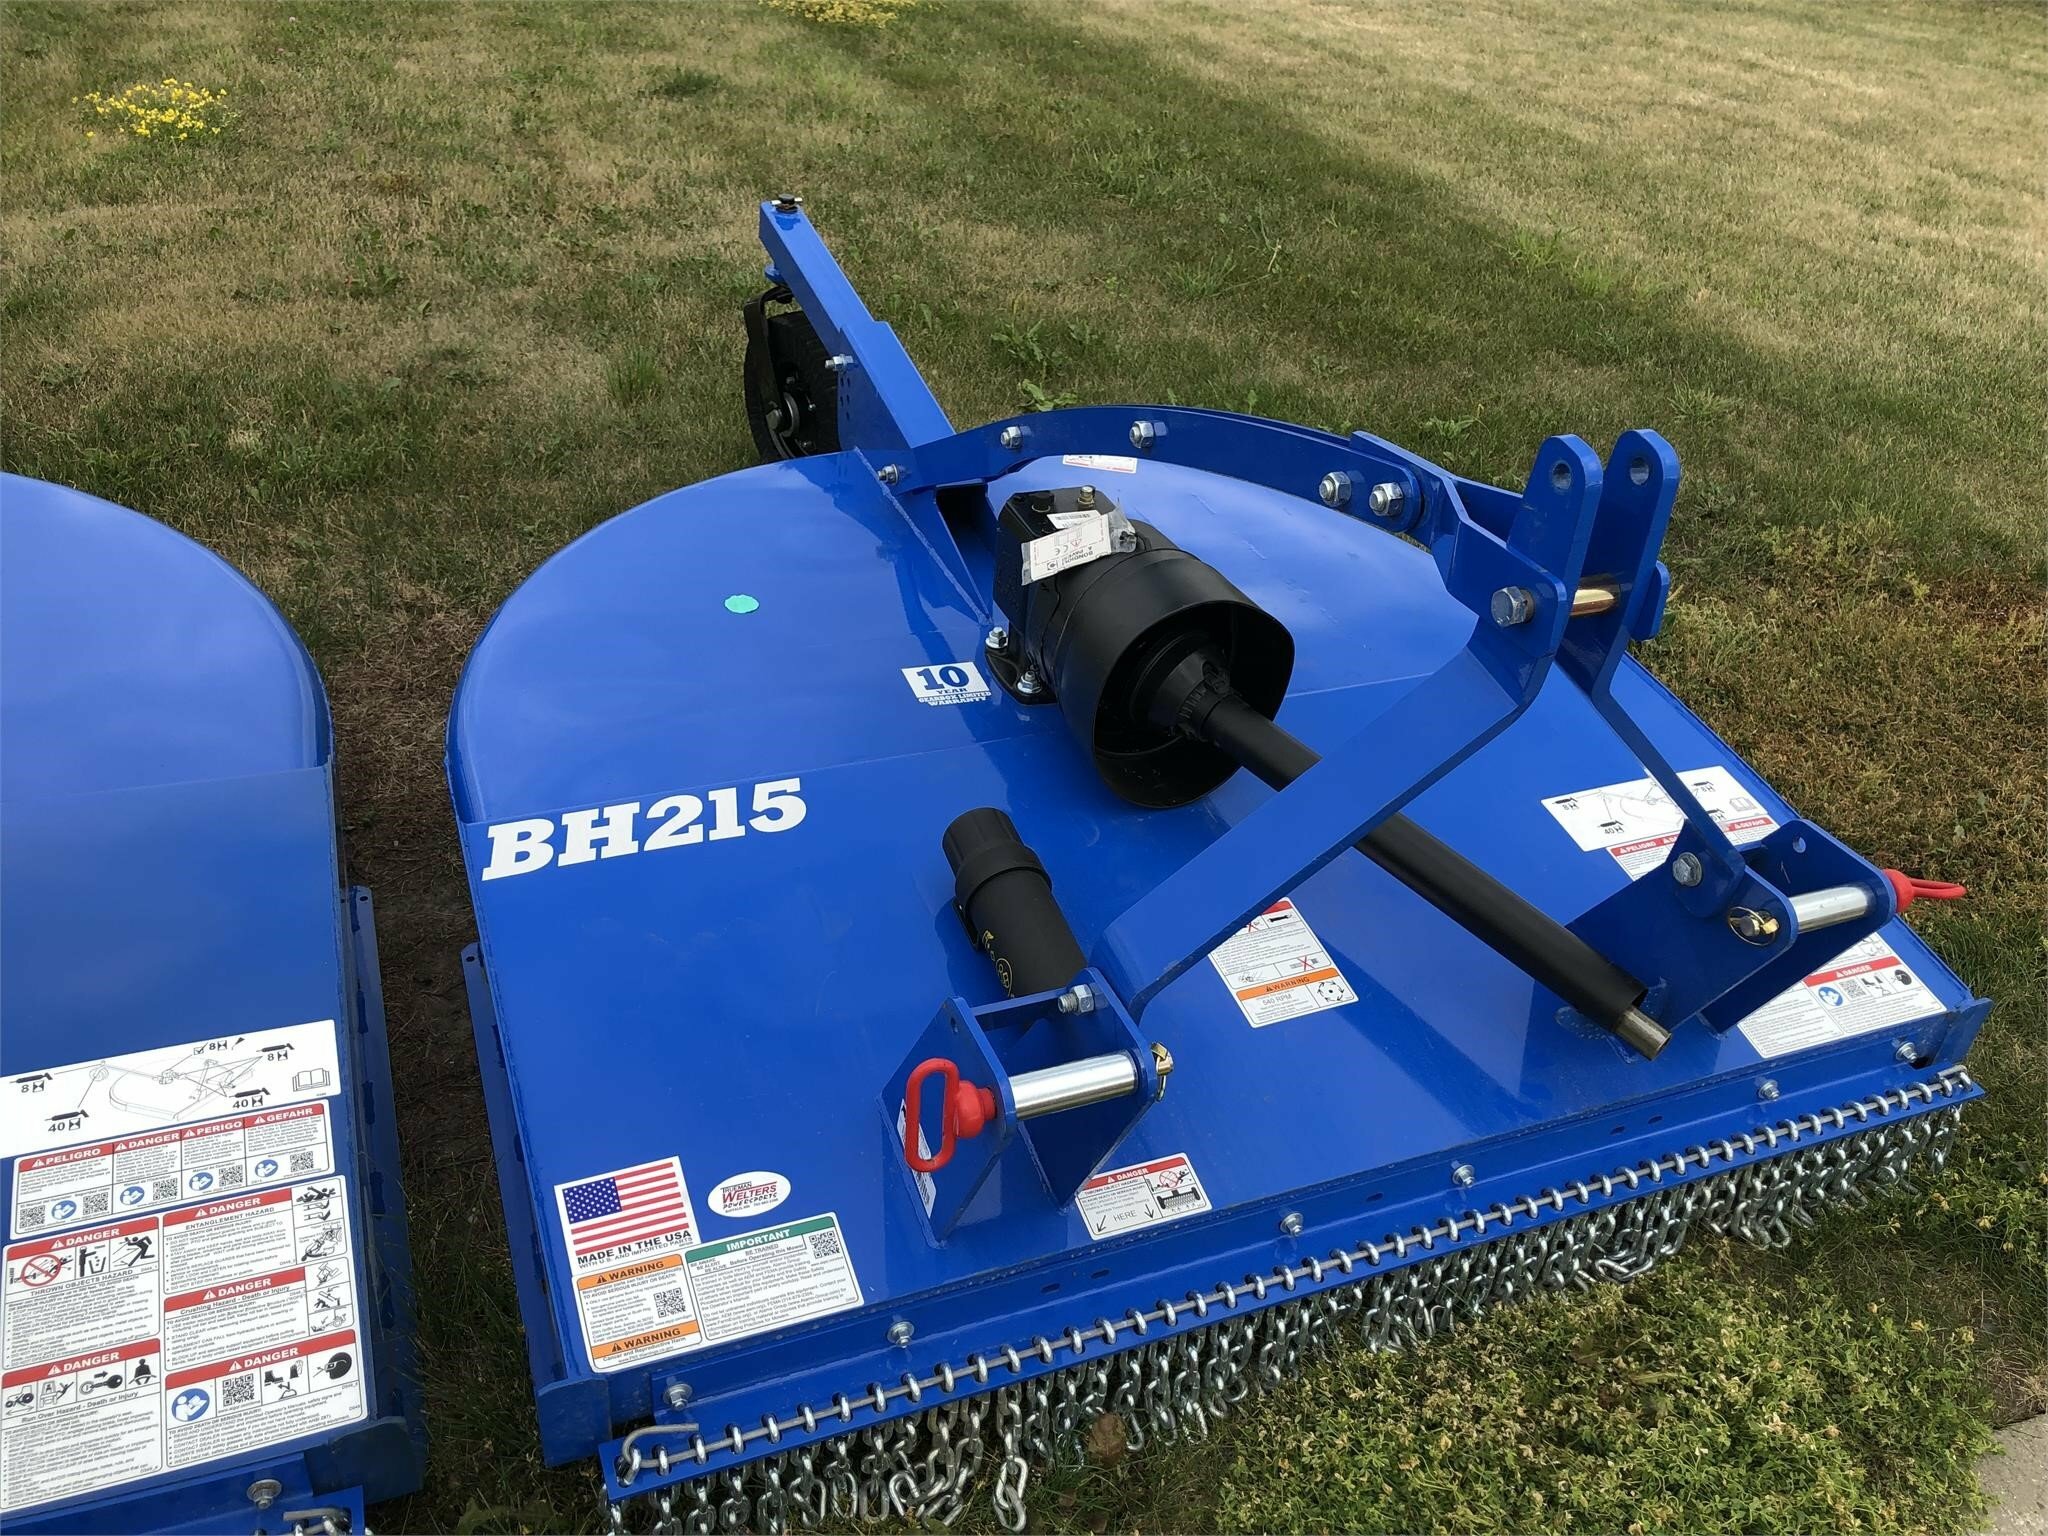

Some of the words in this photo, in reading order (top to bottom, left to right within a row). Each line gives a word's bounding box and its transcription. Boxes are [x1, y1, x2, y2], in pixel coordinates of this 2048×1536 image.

[916, 666, 969, 690] 10
[928, 697, 986, 706] WARRANTY
[482, 778, 807, 881] BH215
[1627, 841, 1656, 852] PELIGRO
[1843, 965, 1872, 976] DANGER
[1274, 977, 1310, 990] WARNING
[1276, 994, 1293, 1002] RPM
[209, 1042, 216, 1050] 8
[267, 1053, 274, 1061] 8
[21, 1082, 29, 1093] 8
[233, 1099, 249, 1109] 40
[267, 1107, 313, 1122] GEFAHR
[48, 1121, 65, 1132] 40
[196, 1120, 242, 1135] PERIGO
[128, 1132, 179, 1148] DANGER
[46, 1147, 100, 1164] PELIGRO
[1117, 1168, 1149, 1180] DANGER
[720, 1181, 752, 1193] TRUEMAN
[723, 1183, 777, 1203] WELTERS
[209, 1197, 260, 1214] DANGER
[723, 1193, 777, 1209] POWERSPORTS
[185, 1213, 243, 1230] ENTANGLEMENT
[245, 1206, 274, 1217] HAZARD
[1113, 1210, 1137, 1222] HERE
[66, 1228, 119, 1246] DANGER
[725, 1227, 791, 1252] IMPORTANT
[576, 1248, 614, 1265] MADE
[617, 1244, 631, 1254] IN
[635, 1236, 663, 1250] THE
[664, 1228, 691, 1242] USA
[578, 1260, 597, 1269] WITH
[614, 1252, 629, 1260] AND
[631, 1242, 668, 1256] IMPORTED
[669, 1235, 692, 1246] PARTS
[729, 1257, 747, 1265] Before
[748, 1250, 774, 1261] Operating
[786, 1243, 803, 1251] Mower
[754, 1243, 779, 1253] TRAINED
[608, 1261, 664, 1280] WARNING
[704, 1260, 720, 1268] ALERT
[30, 1284, 63, 1296] THROWN
[65, 1276, 99, 1288] OBJECTS
[102, 1269, 132, 1280] HAZARD
[218, 1278, 271, 1296] DANGER
[180, 1303, 210, 1315] Crushing
[213, 1298, 236, 1307] Hazard
[241, 1292, 261, 1300] Death
[271, 1285, 289, 1294] Injury
[623, 1327, 680, 1349] WARNING
[634, 1340, 670, 1354] Reproductive
[63, 1350, 119, 1372] DANGER
[243, 1346, 298, 1368] DANGER
[37, 1410, 54, 1419] Over
[56, 1404, 80, 1414] Hazard
[87, 1398, 107, 1407] Death
[118, 1391, 138, 1401] Injury
